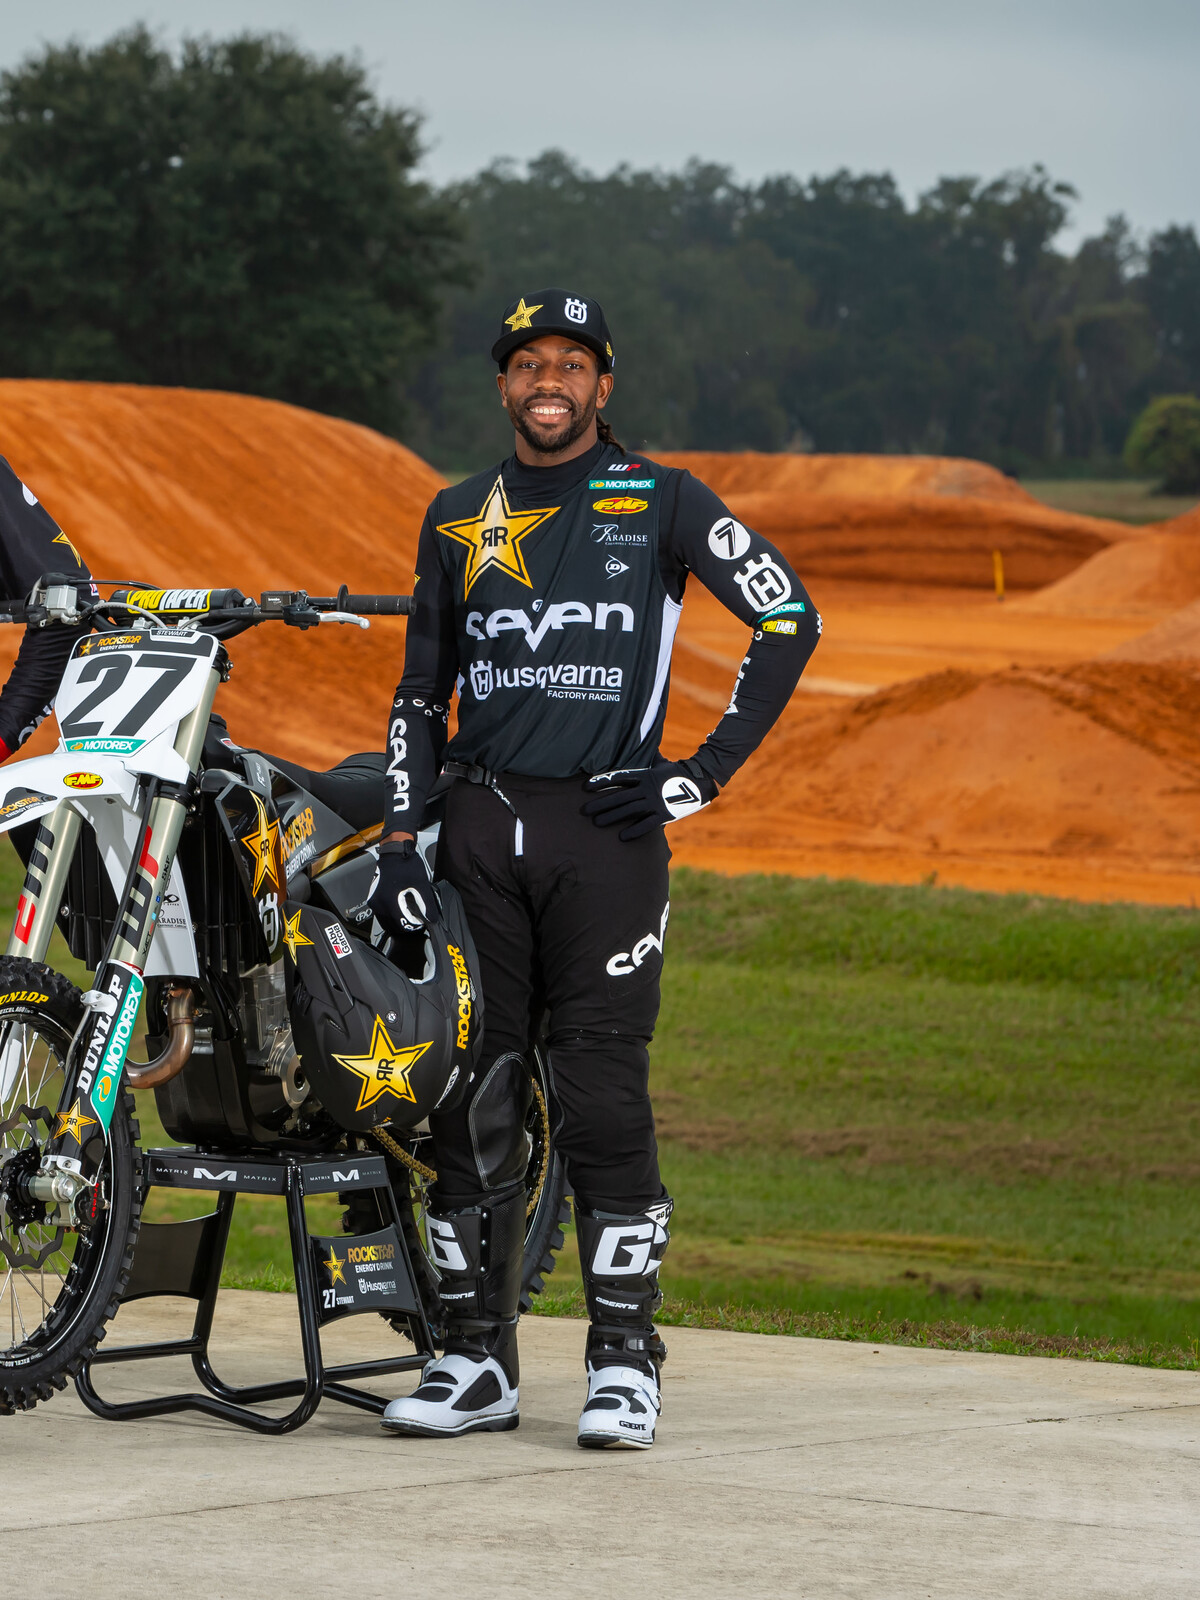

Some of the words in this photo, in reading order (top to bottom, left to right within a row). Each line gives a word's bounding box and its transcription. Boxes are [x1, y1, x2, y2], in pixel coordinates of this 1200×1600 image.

[605, 480, 652, 489] MOTOREX
[97, 635, 142, 647] ROCKSTAR
[61, 654, 196, 736] 27
[547, 690, 587, 700] FACTORY
[588, 693, 620, 702] RACING
[83, 740, 134, 751] MOTOREX
[66, 774, 101, 787] FMF
[5, 806, 26, 818] ENERGY
[25, 801, 43, 812] DRINK
[327, 928, 340, 945] Abu
[334, 924, 351, 954] Garcia
[447, 944, 472, 1050] ROCKSTAR
[105, 987, 142, 1077] MOTOREX
[155, 1167, 189, 1175] MATRIX
[347, 1244, 395, 1264] ROCKSTAR
[355, 1264, 376, 1273] ENERGY
[376, 1261, 394, 1270] DRINK
[367, 1280, 397, 1292] Husqvarna
[322, 1289, 336, 1309] 27
[336, 1296, 355, 1305] STEWART
[595, 1296, 639, 1310] GAERNE
